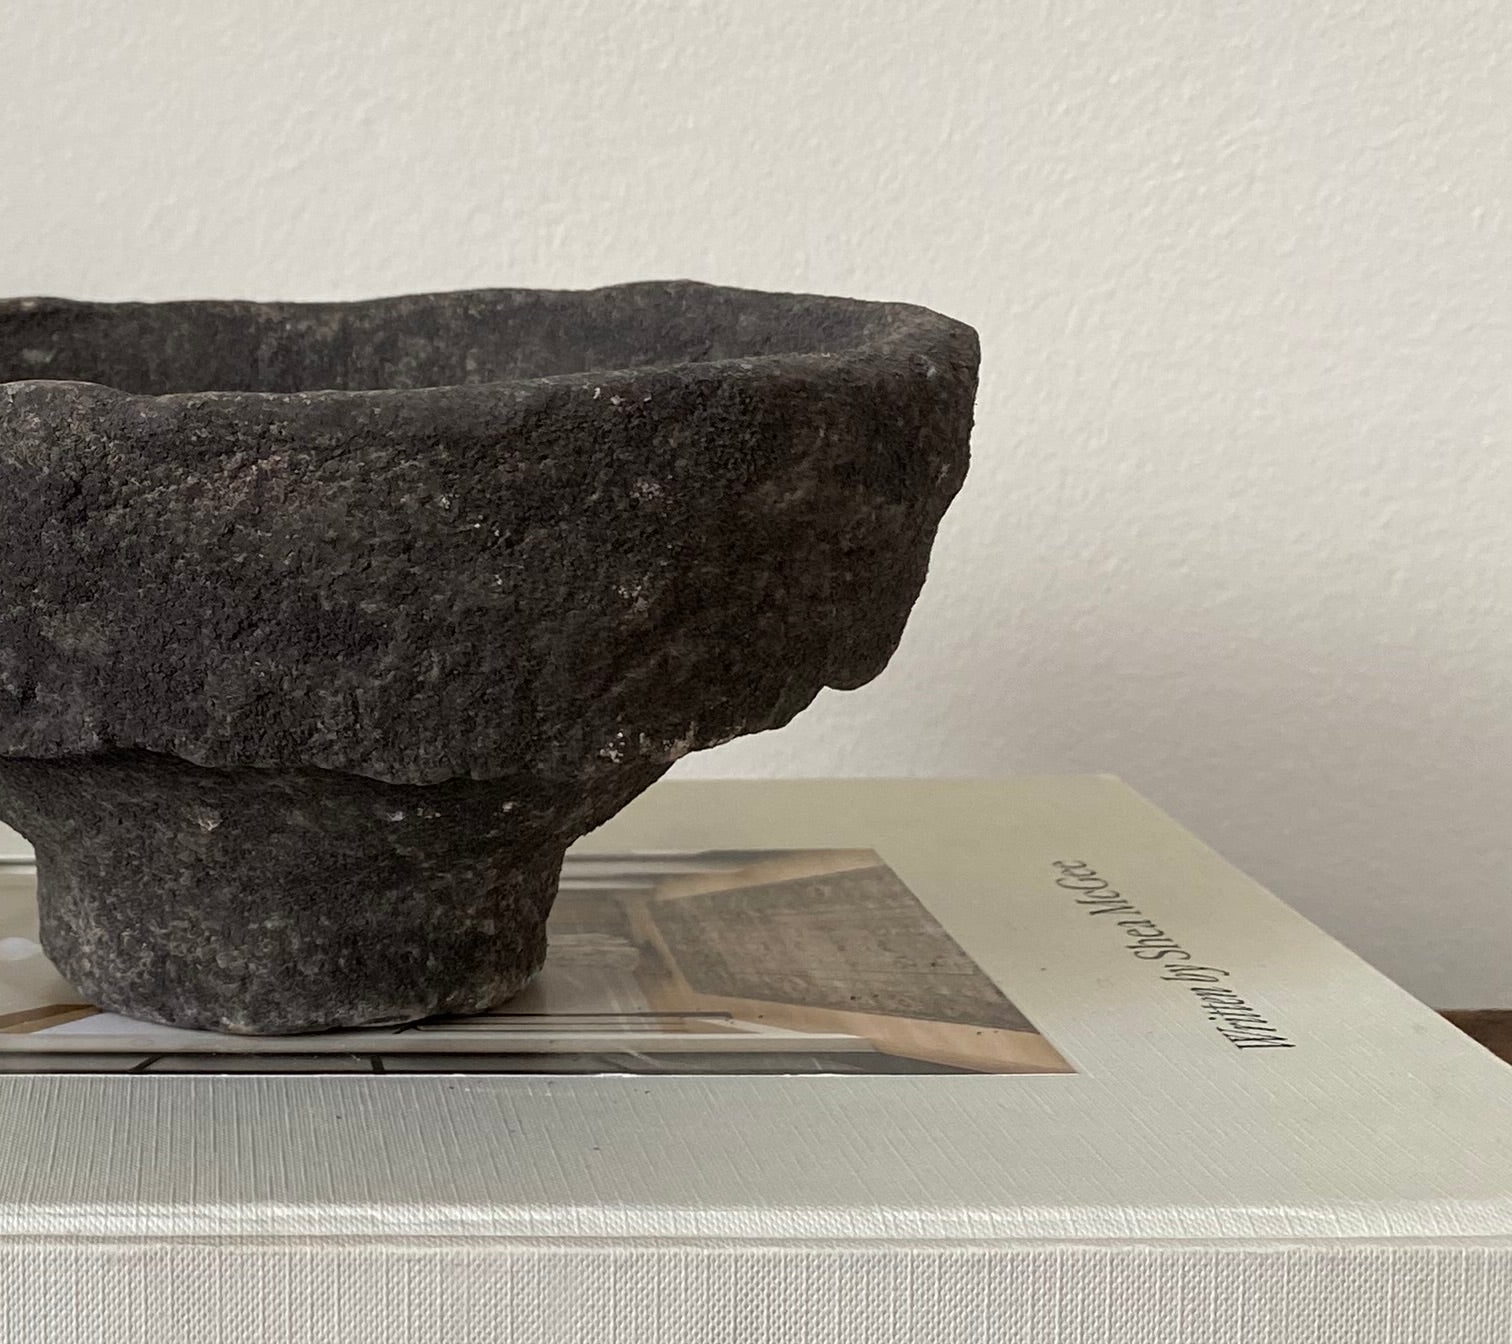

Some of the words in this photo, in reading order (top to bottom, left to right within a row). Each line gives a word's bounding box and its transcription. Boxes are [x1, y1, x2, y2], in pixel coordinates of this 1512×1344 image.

[1052, 859, 1142, 916] McGee
[1116, 919, 1191, 960] Shea
[1160, 963, 1230, 983] by
[1190, 987, 1296, 1049] Written
